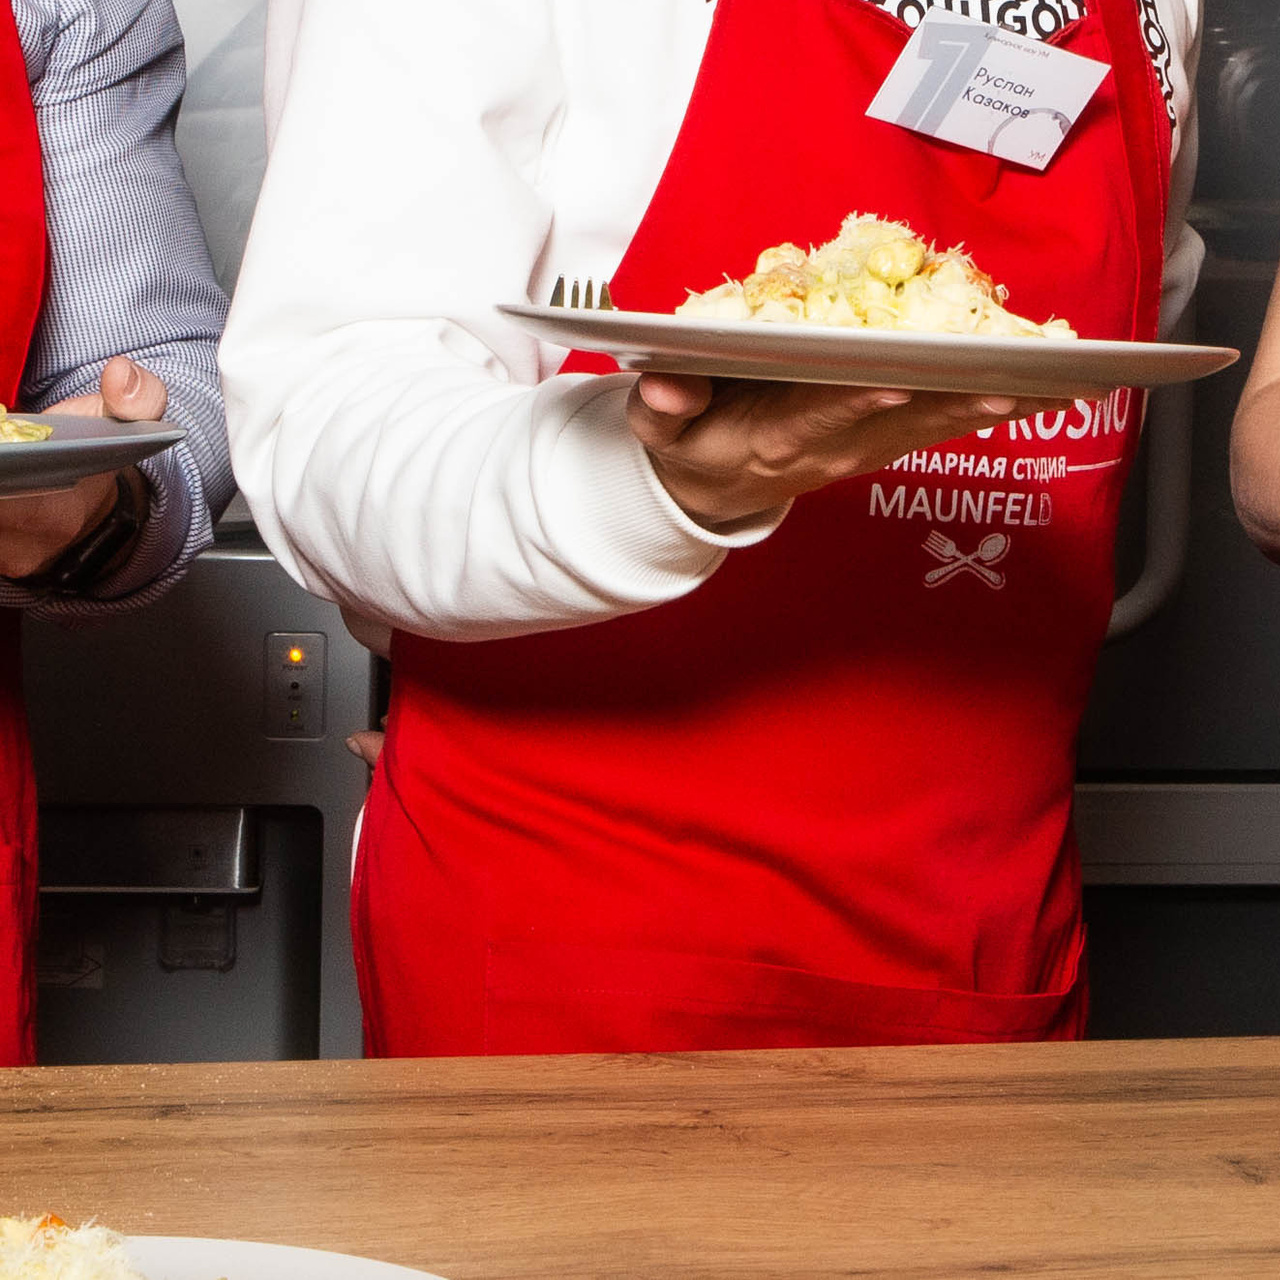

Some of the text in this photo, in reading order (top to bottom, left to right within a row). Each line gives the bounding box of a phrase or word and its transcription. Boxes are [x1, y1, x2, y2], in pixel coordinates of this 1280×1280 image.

[974, 67, 1036, 99] Руслан
[962, 86, 1031, 120] Казаков
[884, 450, 1067, 484] ИНАРНАЯ СТУДИЯ
[868, 482, 1052, 527] MAUNFELD
